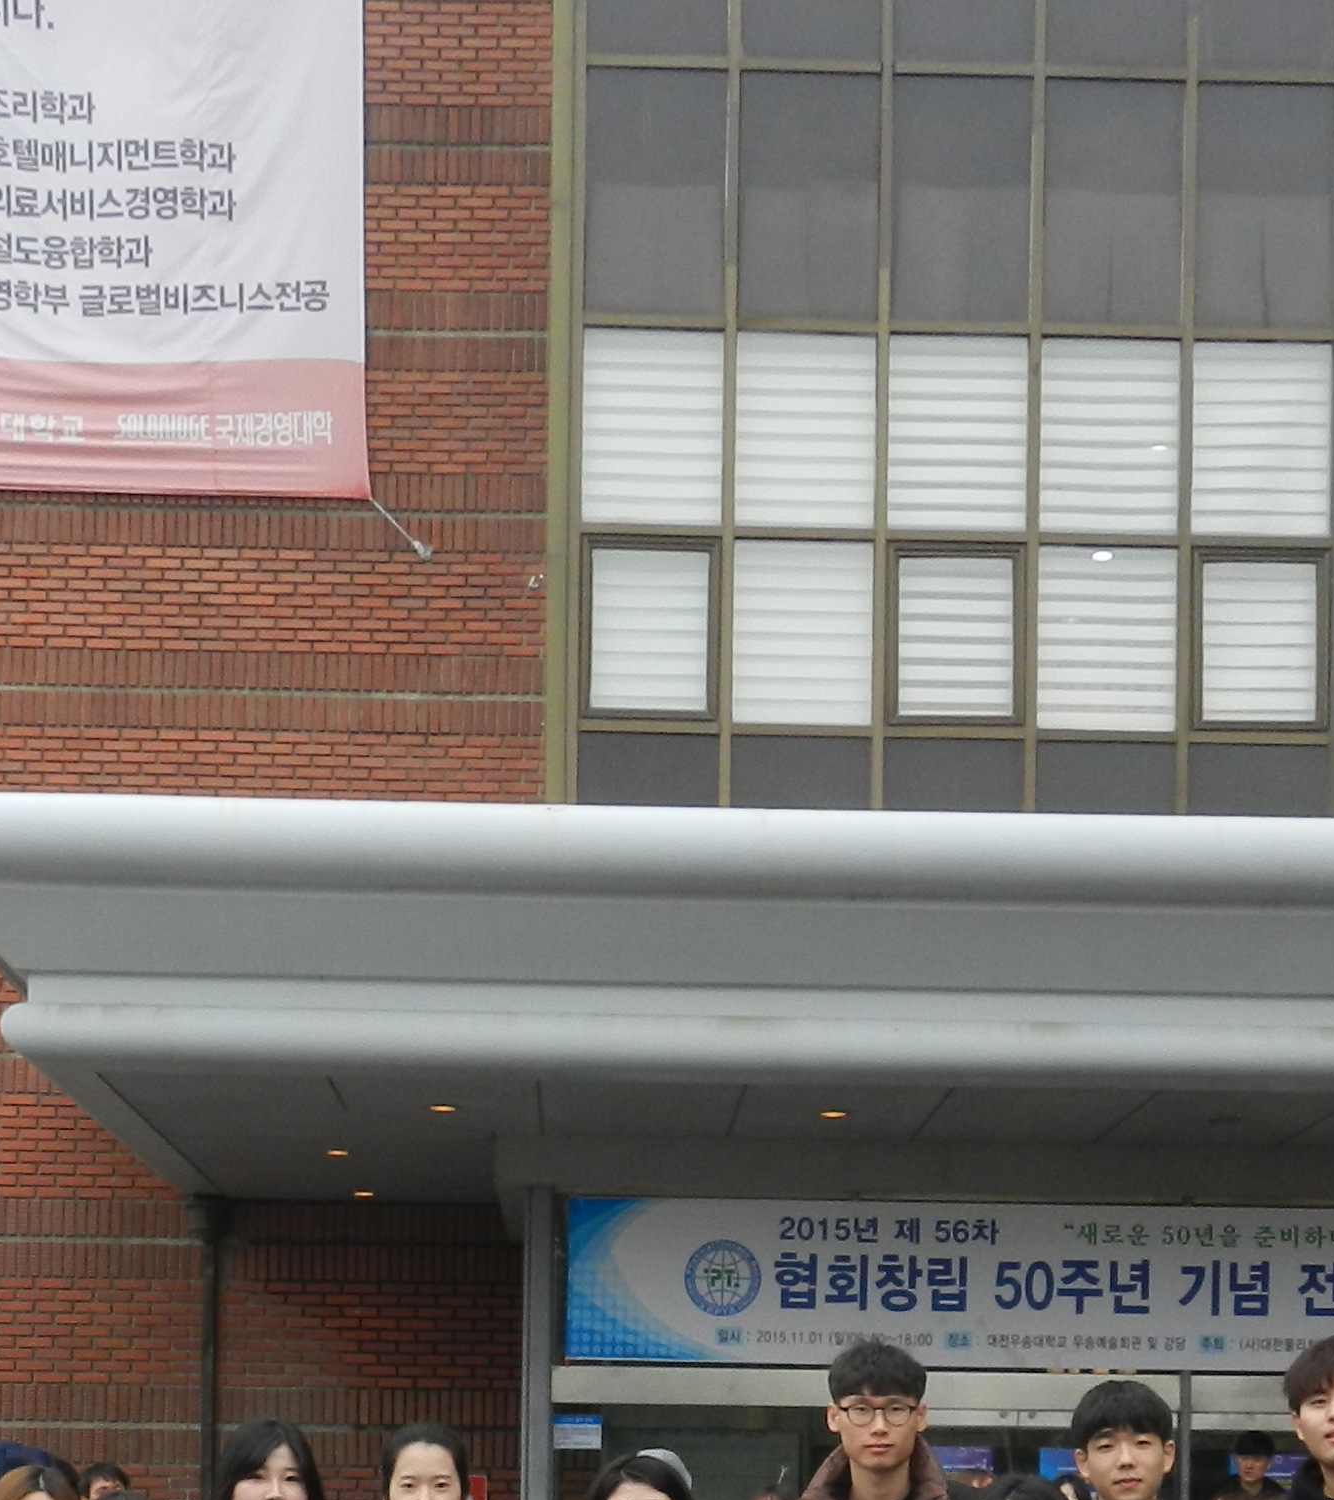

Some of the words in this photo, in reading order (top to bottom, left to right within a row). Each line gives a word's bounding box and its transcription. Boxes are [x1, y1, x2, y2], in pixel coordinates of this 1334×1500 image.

[78, 279, 330, 317] 글로벌비즈니스전공
[214, 411, 333, 446] 국제경영대학
[779, 1216, 879, 1244] 2015년
[894, 1217, 921, 1245] 제
[934, 1218, 1000, 1246] 56차
[1161, 1223, 1240, 1249] 50년을
[774, 1251, 967, 1312] 협회창립
[994, 1258, 1150, 1315] 50주년
[1178, 1259, 1270, 1317] 기념
